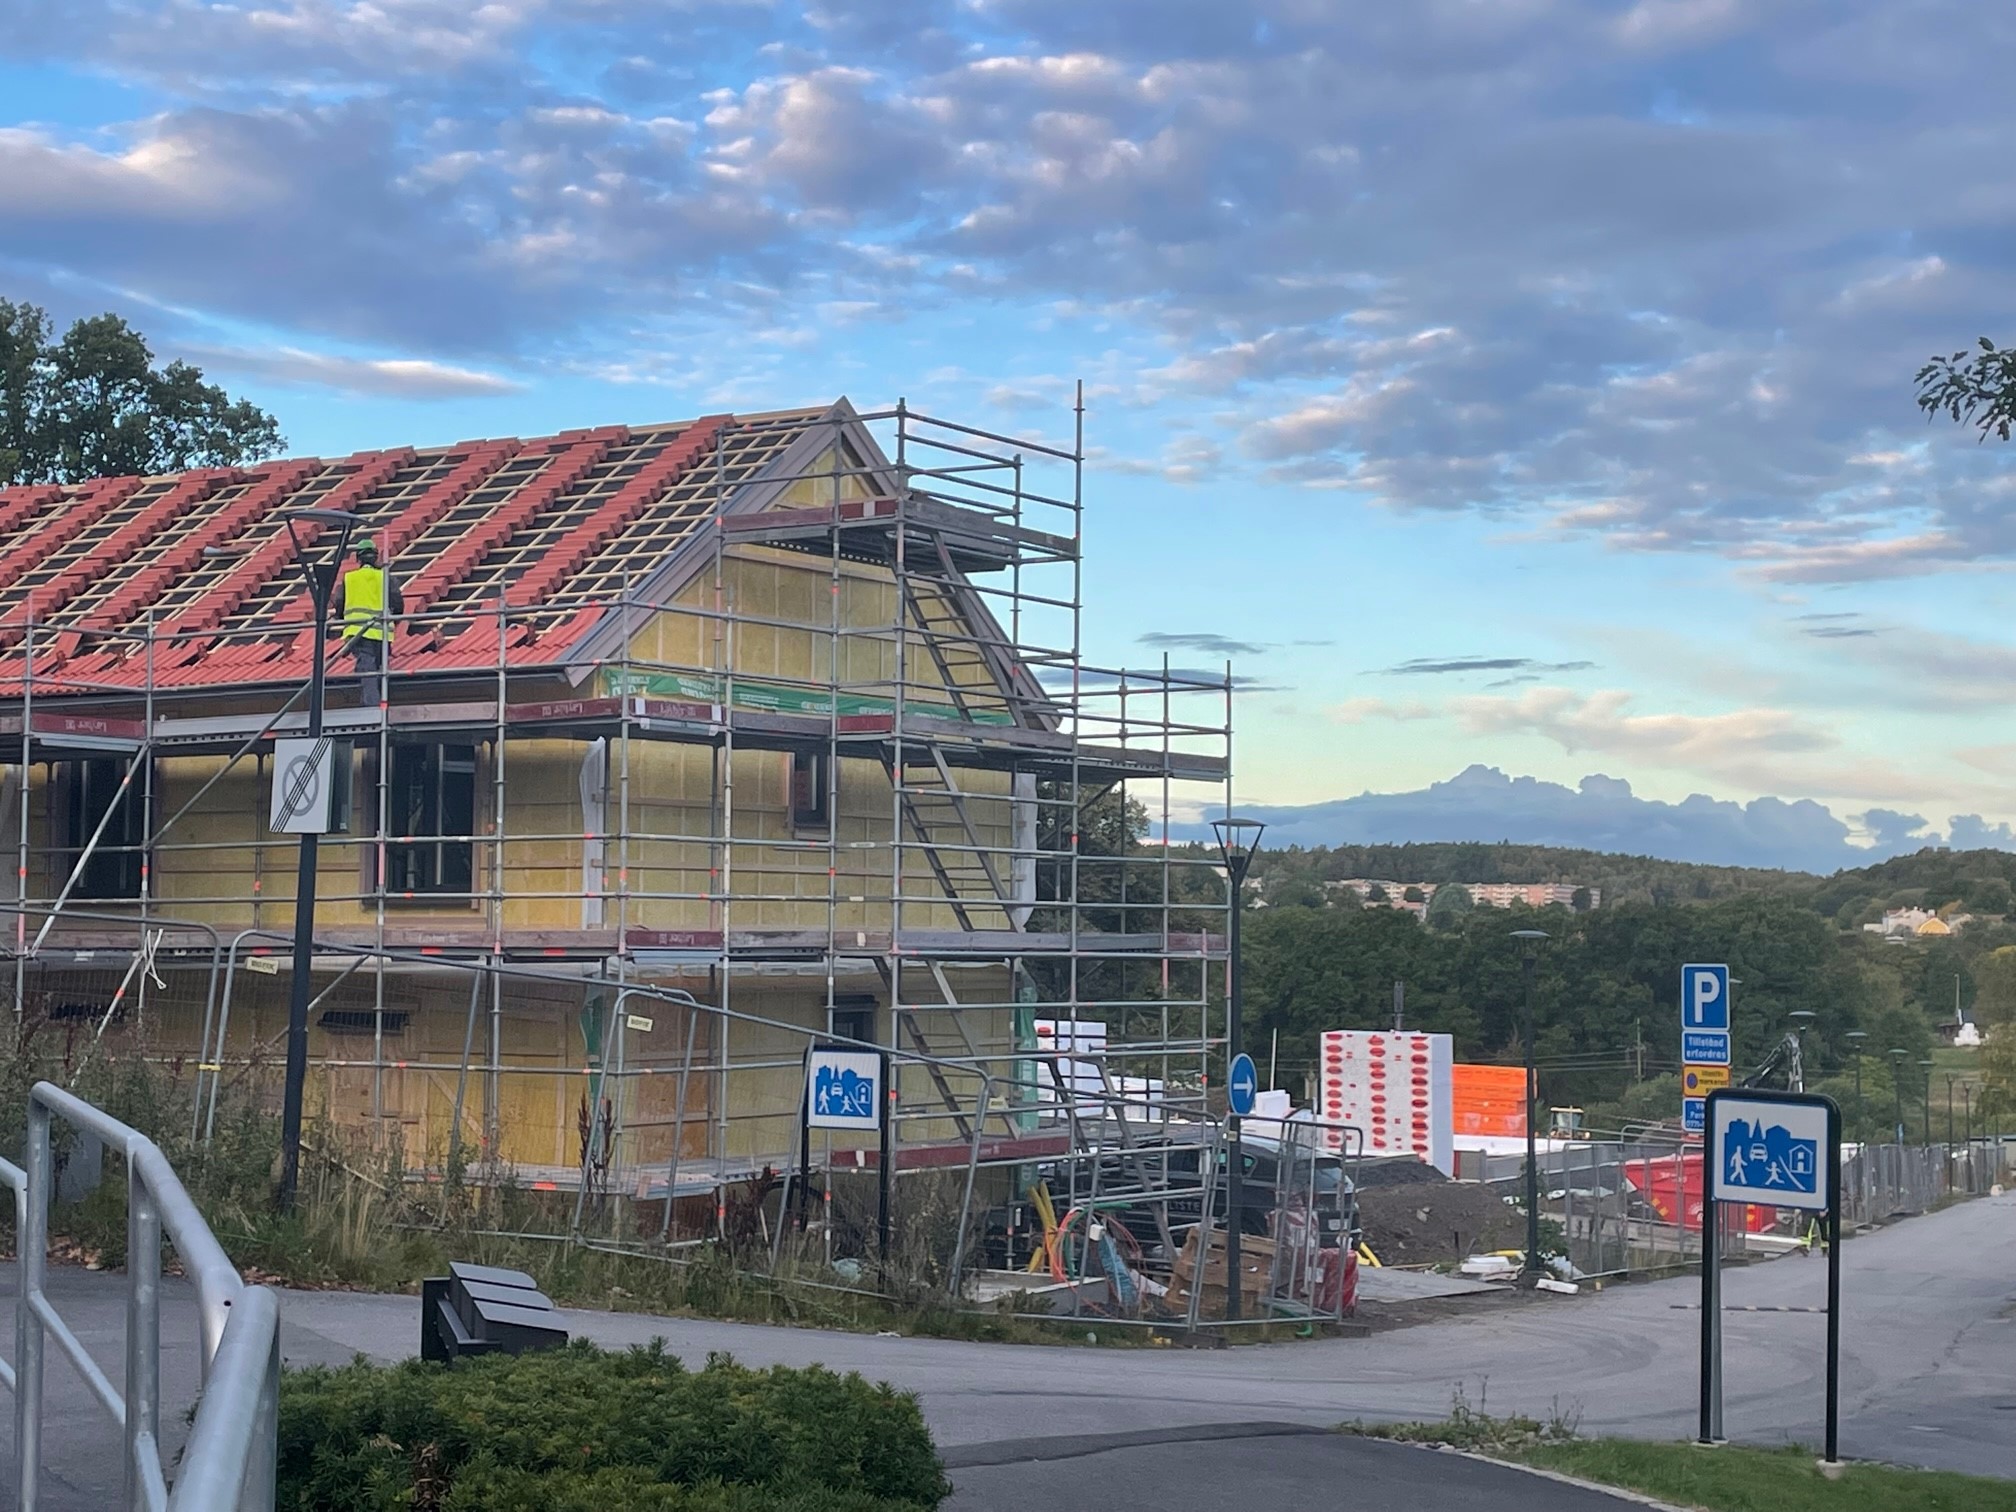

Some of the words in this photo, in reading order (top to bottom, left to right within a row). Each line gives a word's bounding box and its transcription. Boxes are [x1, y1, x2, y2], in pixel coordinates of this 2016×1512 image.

[1694, 972, 1720, 1023] P
[1688, 1036, 1724, 1048] Tillstånd
[1686, 1049, 1726, 1060] erfordras
